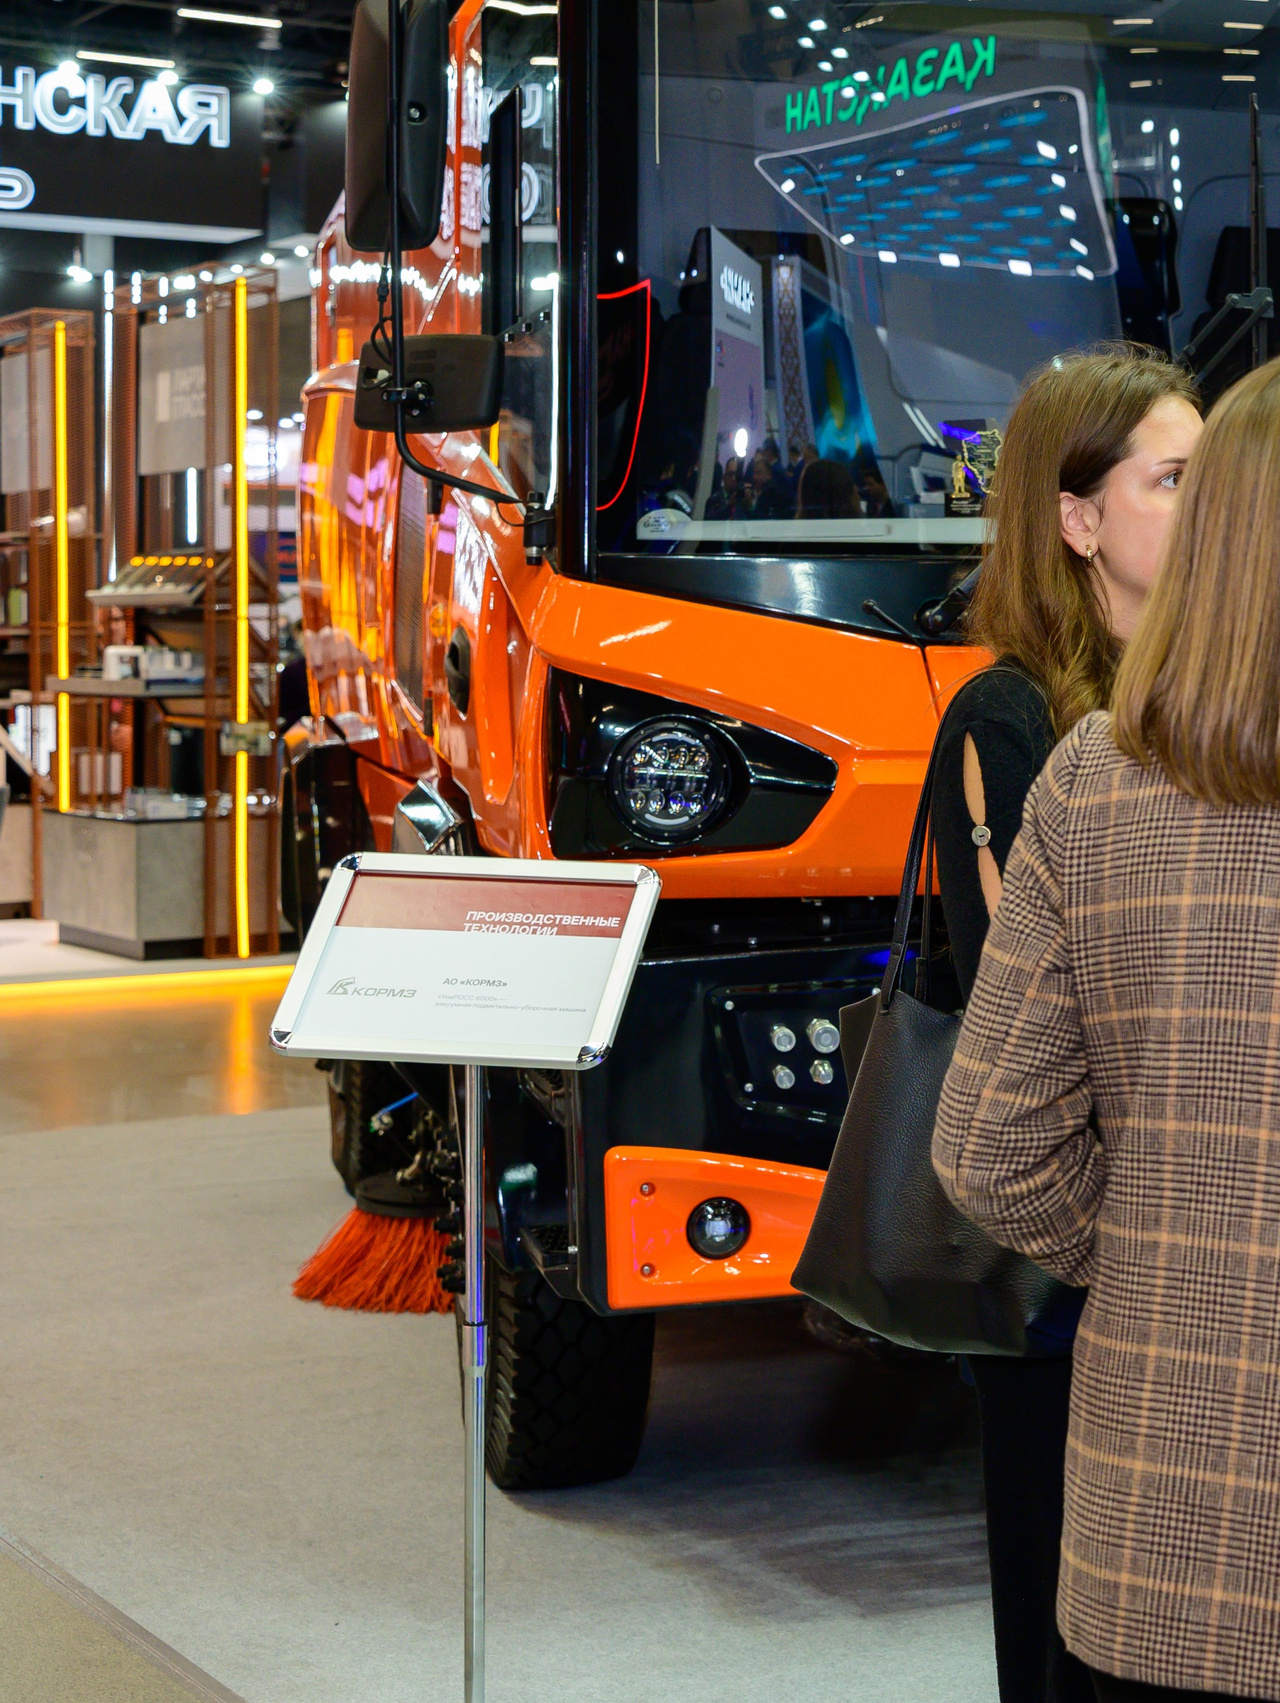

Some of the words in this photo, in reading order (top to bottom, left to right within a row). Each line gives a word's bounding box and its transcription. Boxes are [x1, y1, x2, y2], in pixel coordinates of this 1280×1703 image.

[465, 911, 621, 928] ПРОИЗВОДСТВЕННЫЕ
[463, 923, 558, 937] ТЕХНОЛОГИИ
[442, 978, 458, 986] АО
[459, 978, 508, 988] «КОРМЗ»
[350, 987, 418, 999] КОРМЗ
